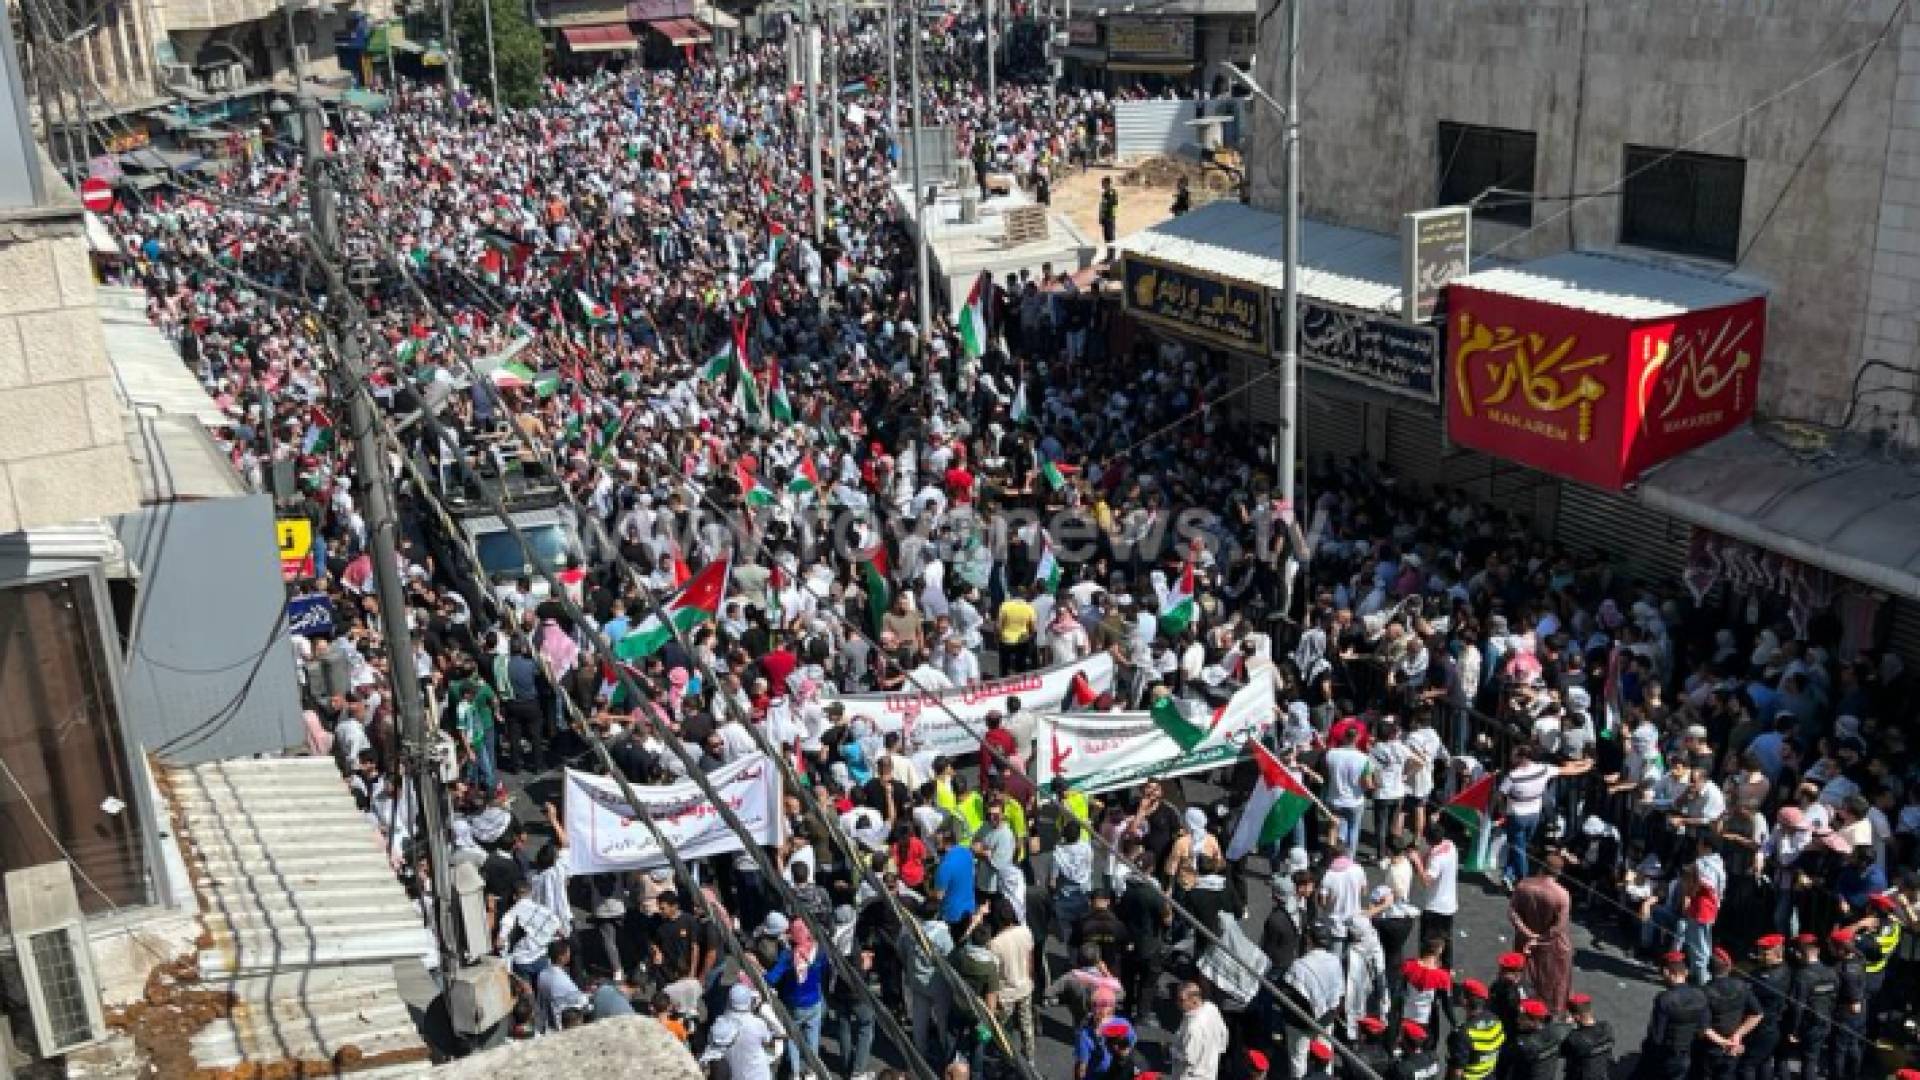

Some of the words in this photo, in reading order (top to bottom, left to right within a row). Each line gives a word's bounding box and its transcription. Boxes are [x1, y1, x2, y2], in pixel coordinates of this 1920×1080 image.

[1455, 312, 1613, 443] مكارم
[1639, 316, 1754, 436] مكارم
[1487, 409, 1569, 441] MAKAREM
[1663, 410, 1725, 434] MAKAREM
